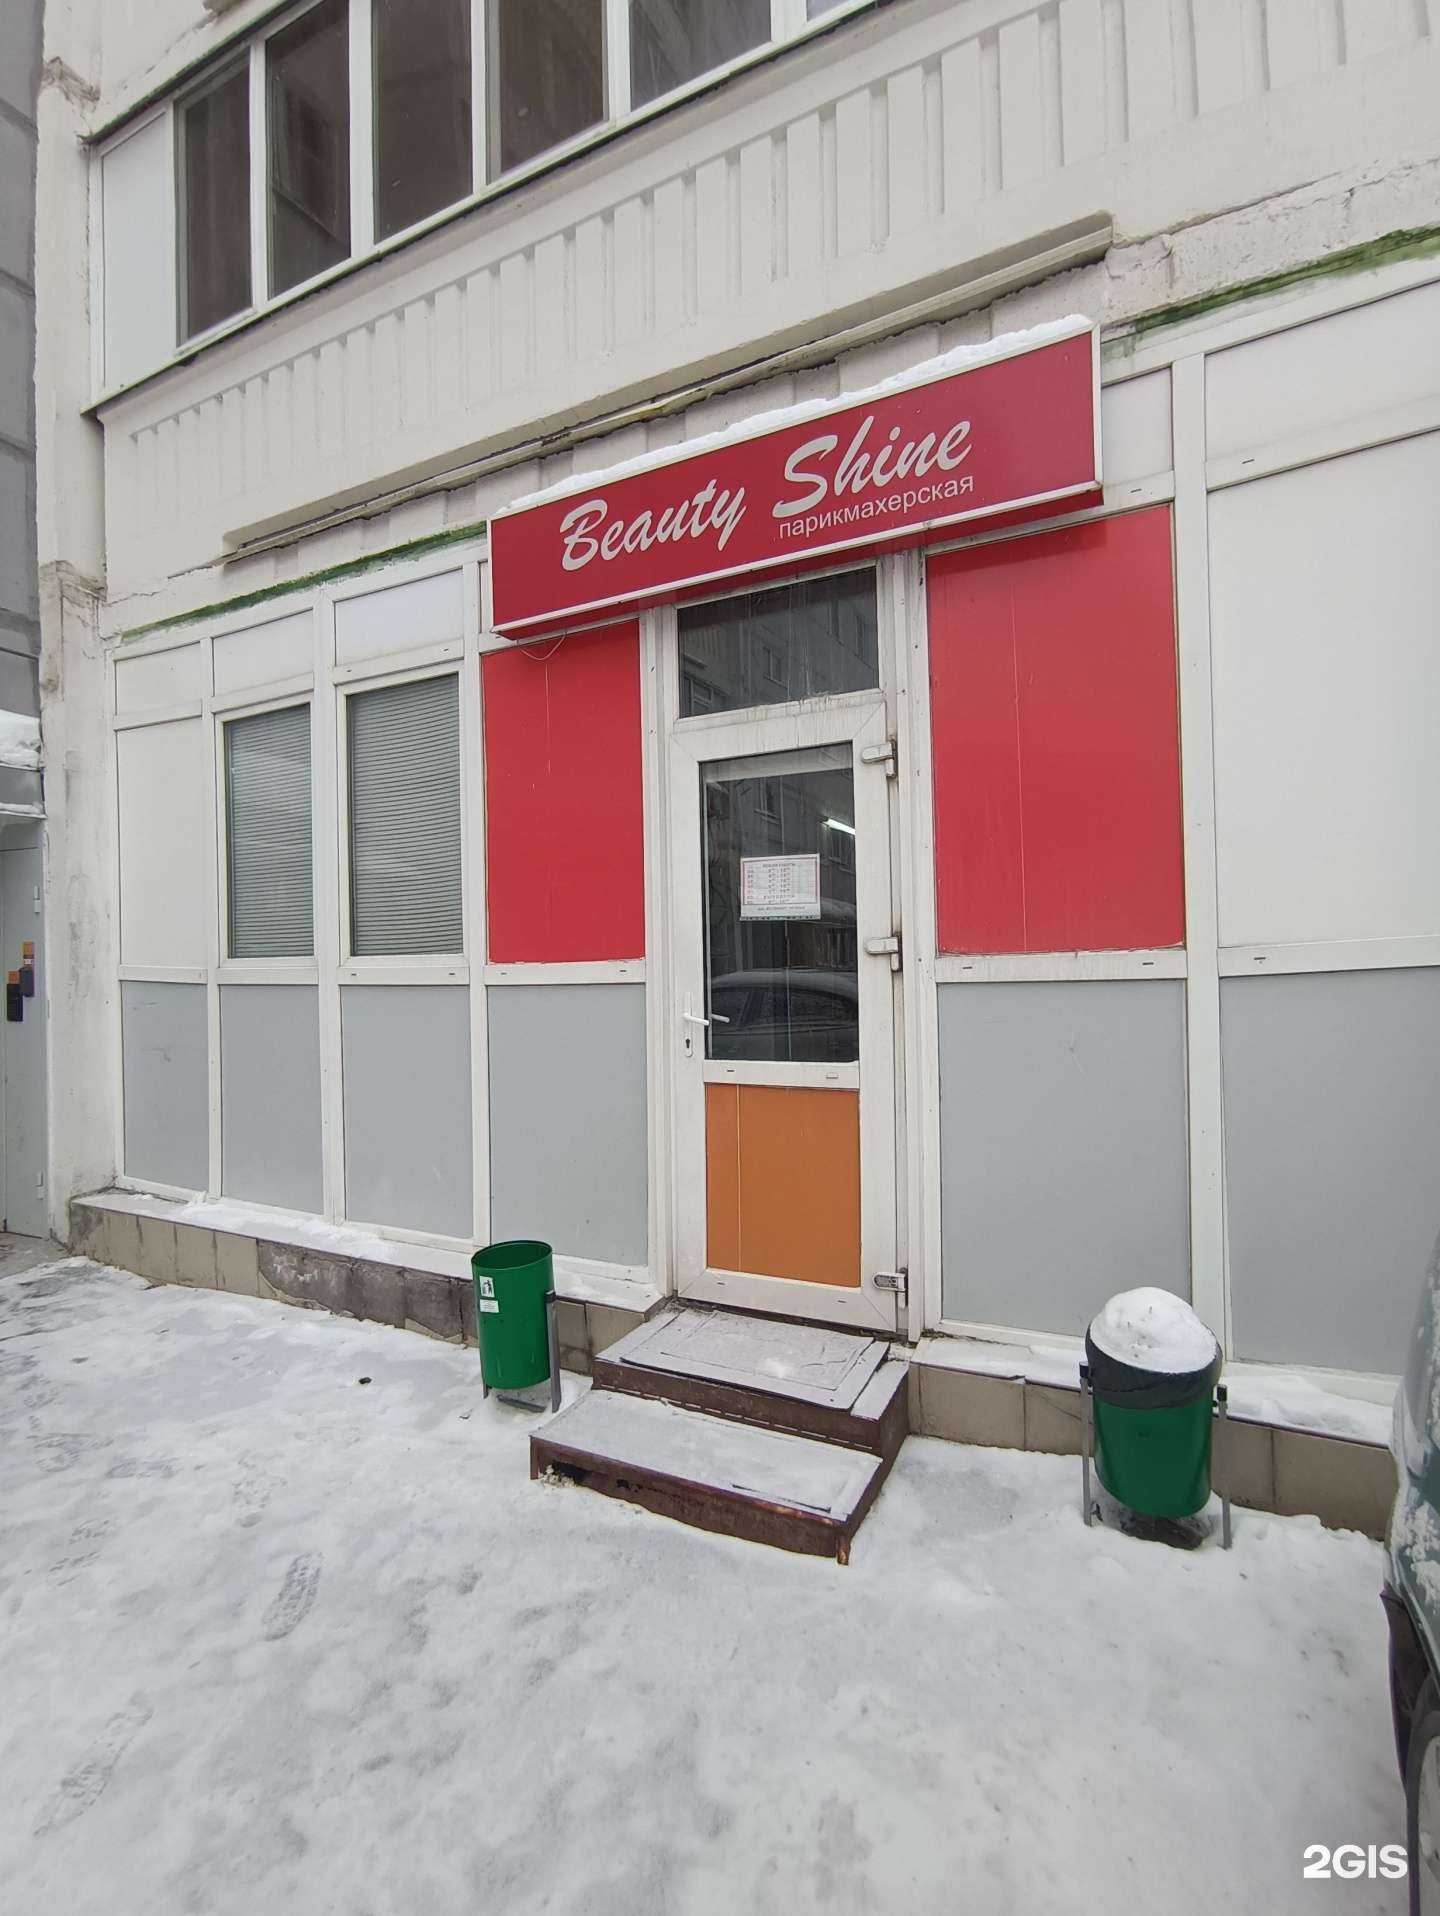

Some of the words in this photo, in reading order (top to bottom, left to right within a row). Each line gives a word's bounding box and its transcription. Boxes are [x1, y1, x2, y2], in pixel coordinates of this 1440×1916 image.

[560, 479, 746, 572] Beauty
[772, 415, 972, 518] Shine
[779, 475, 974, 540] парикмахерская
